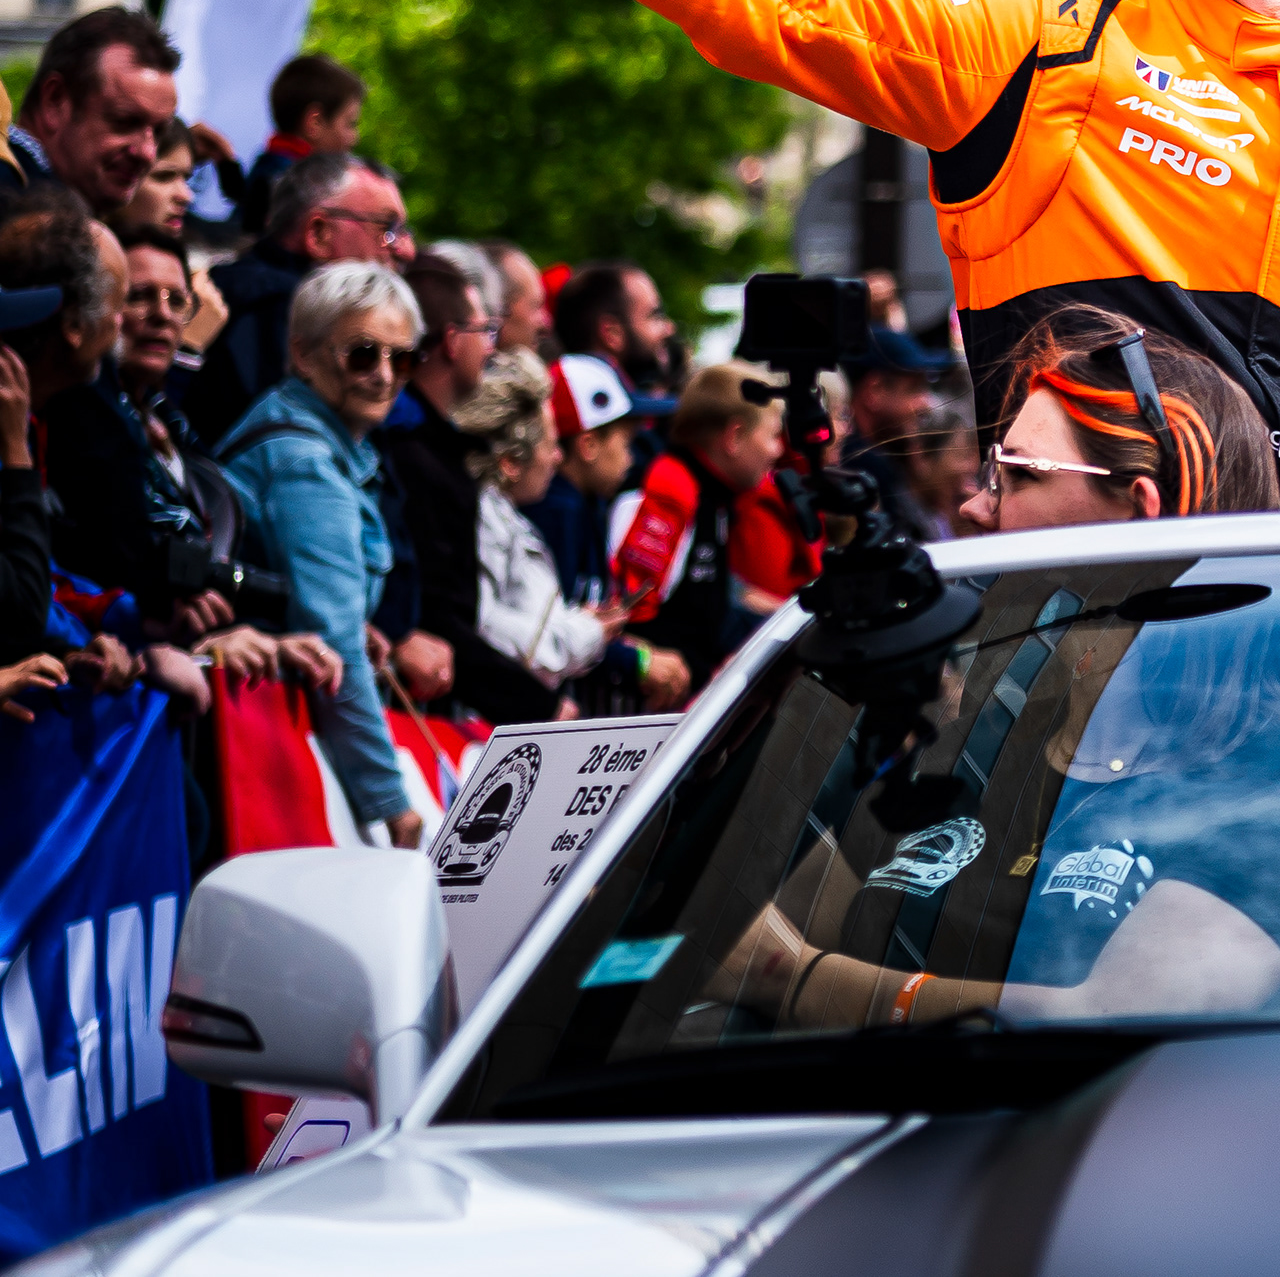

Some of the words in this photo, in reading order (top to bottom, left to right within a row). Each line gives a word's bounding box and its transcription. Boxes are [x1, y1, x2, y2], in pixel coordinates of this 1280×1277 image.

[1118, 127, 1232, 186] PRIO
[577, 744, 611, 774] 28
[564, 785, 613, 817] DES
[551, 828, 579, 852] des
[543, 863, 568, 886] 14
[1056, 853, 1130, 882] Global
